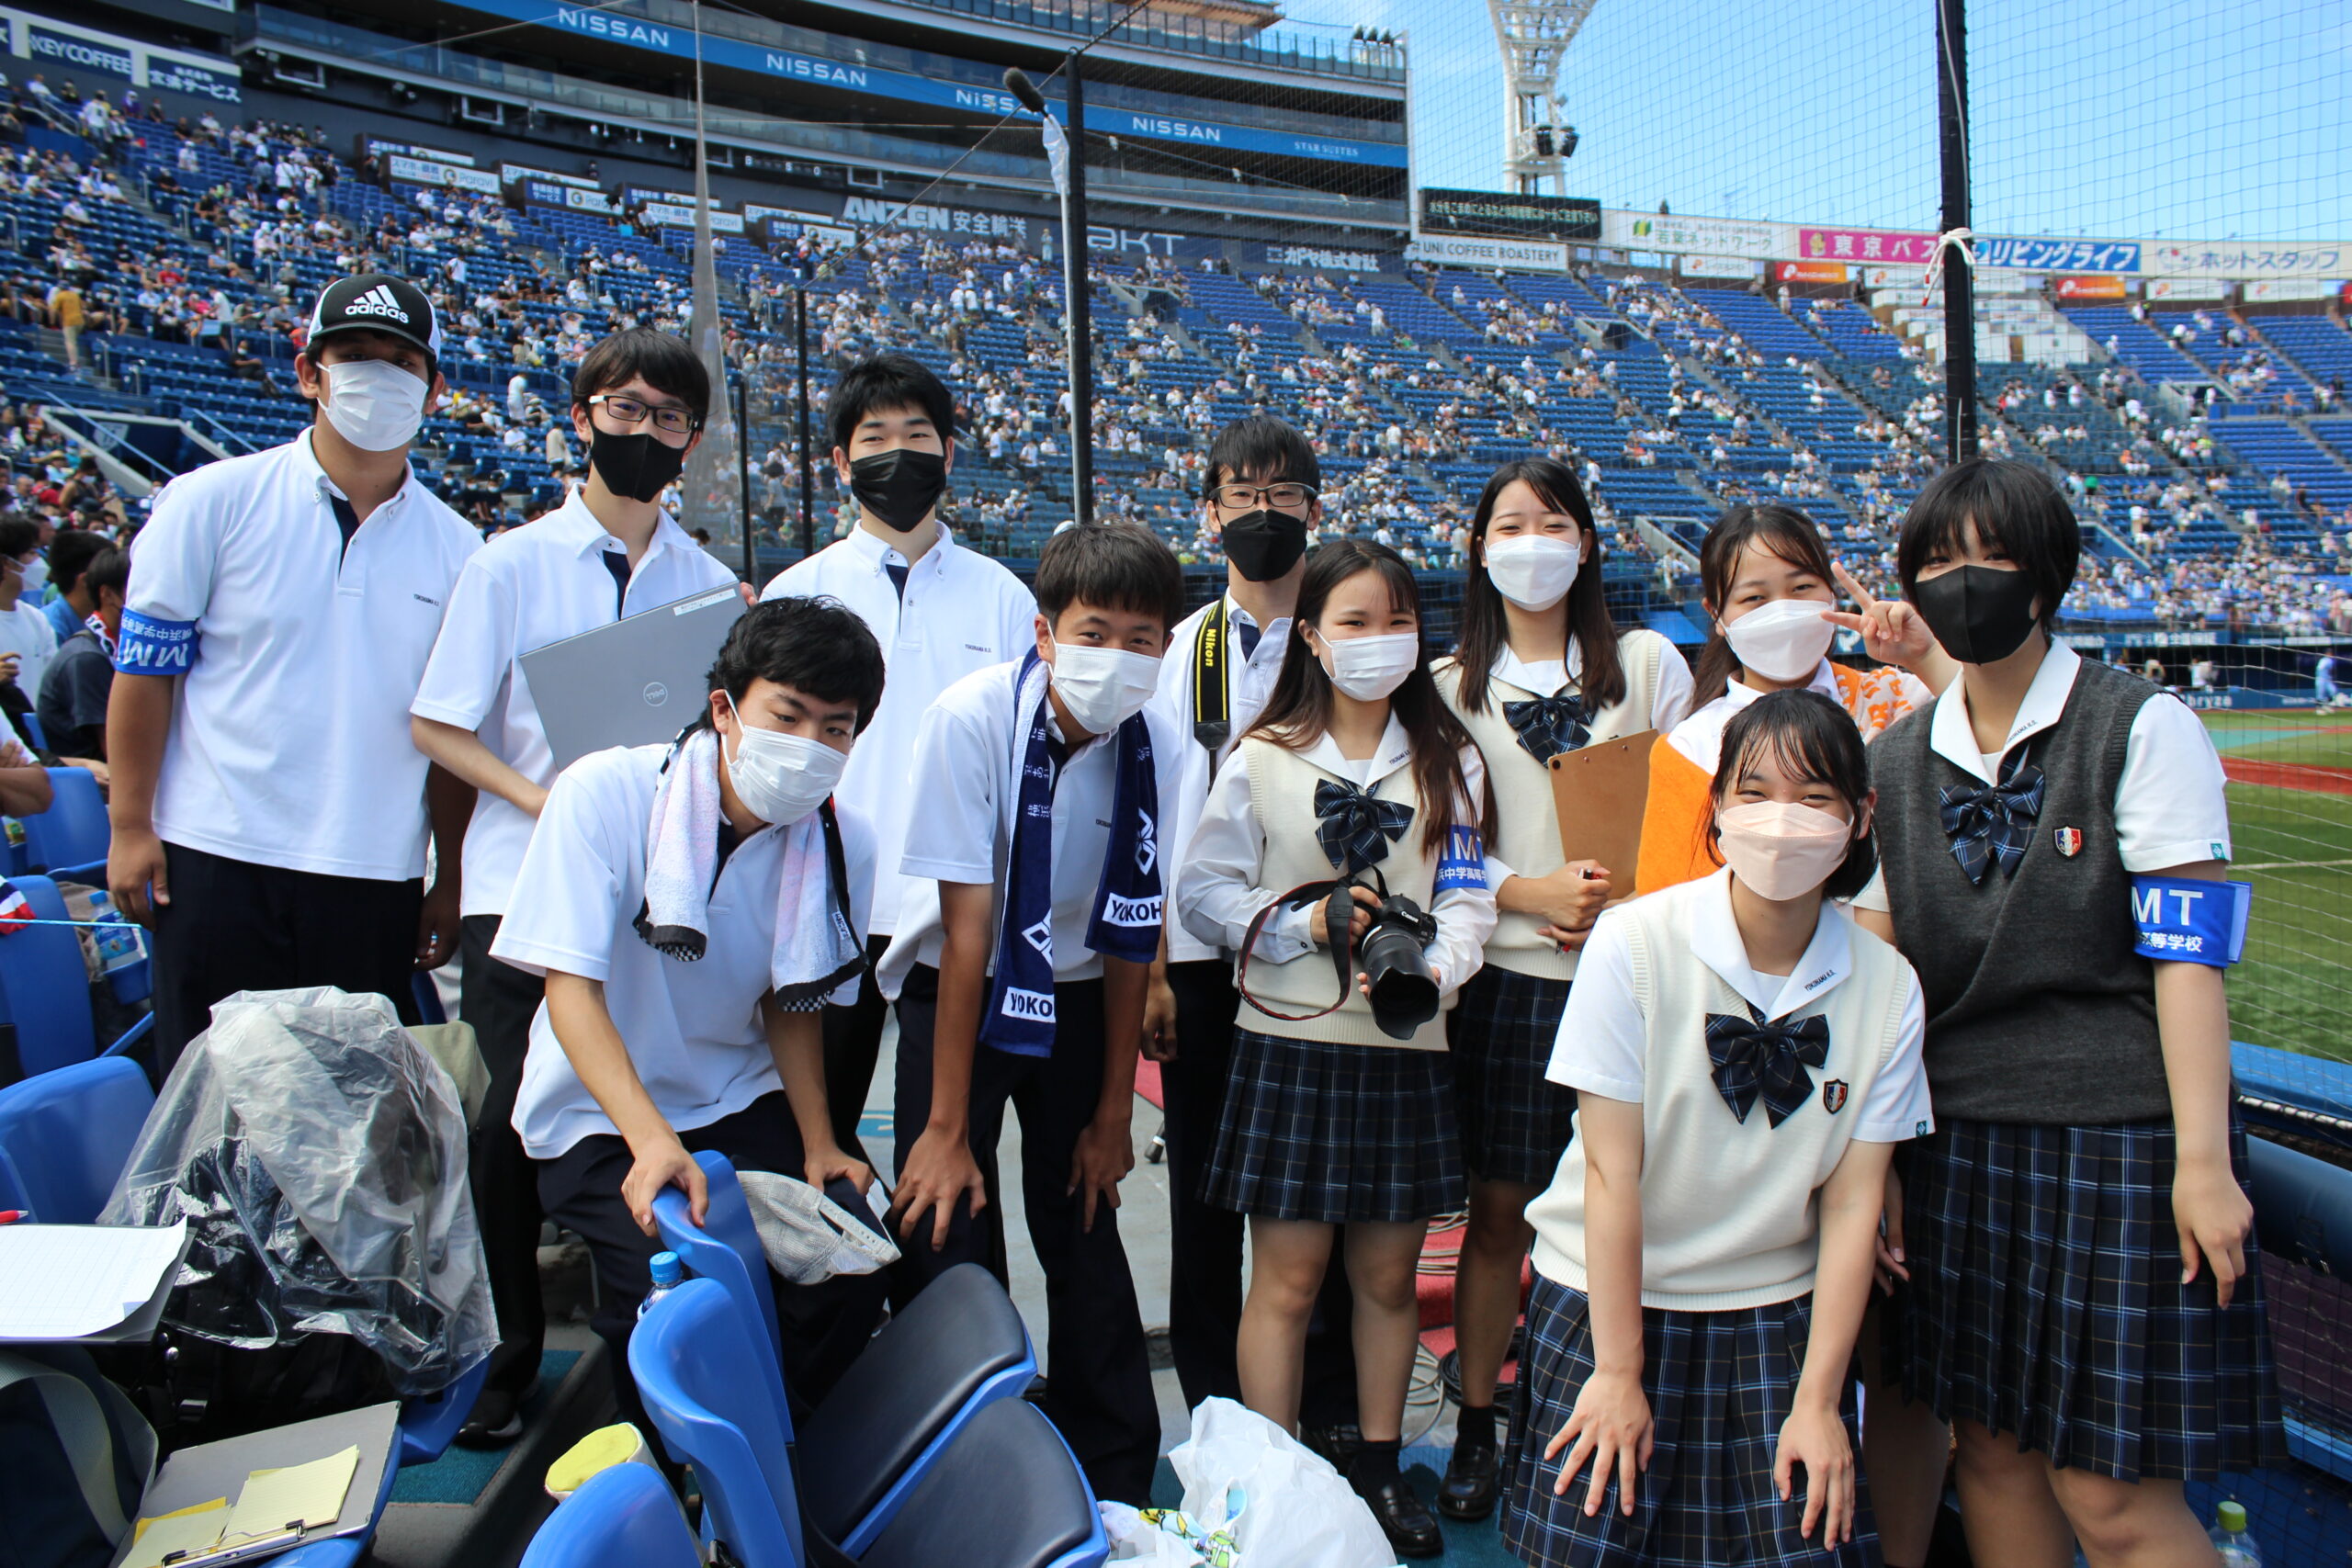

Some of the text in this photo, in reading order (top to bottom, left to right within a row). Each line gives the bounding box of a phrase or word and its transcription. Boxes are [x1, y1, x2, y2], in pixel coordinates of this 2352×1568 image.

[559, 7, 670, 48] NISSAN
[66, 43, 132, 75] COFFEE
[766, 53, 866, 87] NISSAN
[1132, 117, 1221, 142] NISSAN
[458, 172, 493, 188] Paravi
[842, 196, 1027, 239] ANZEN 安全輸送
[1423, 242, 1559, 262] UNI COFFEE ROASTERY
[1657, 229, 1773, 252] 若葉ネットワーク
[1993, 240, 2137, 270] リビングライフ
[2202, 250, 2340, 270] ホットスタッフ
[345, 303, 410, 324] adidas
[1204, 628, 1217, 668] Nikon
[1401, 910, 1419, 923] Canon
[1010, 992, 1054, 1018] YOKO
